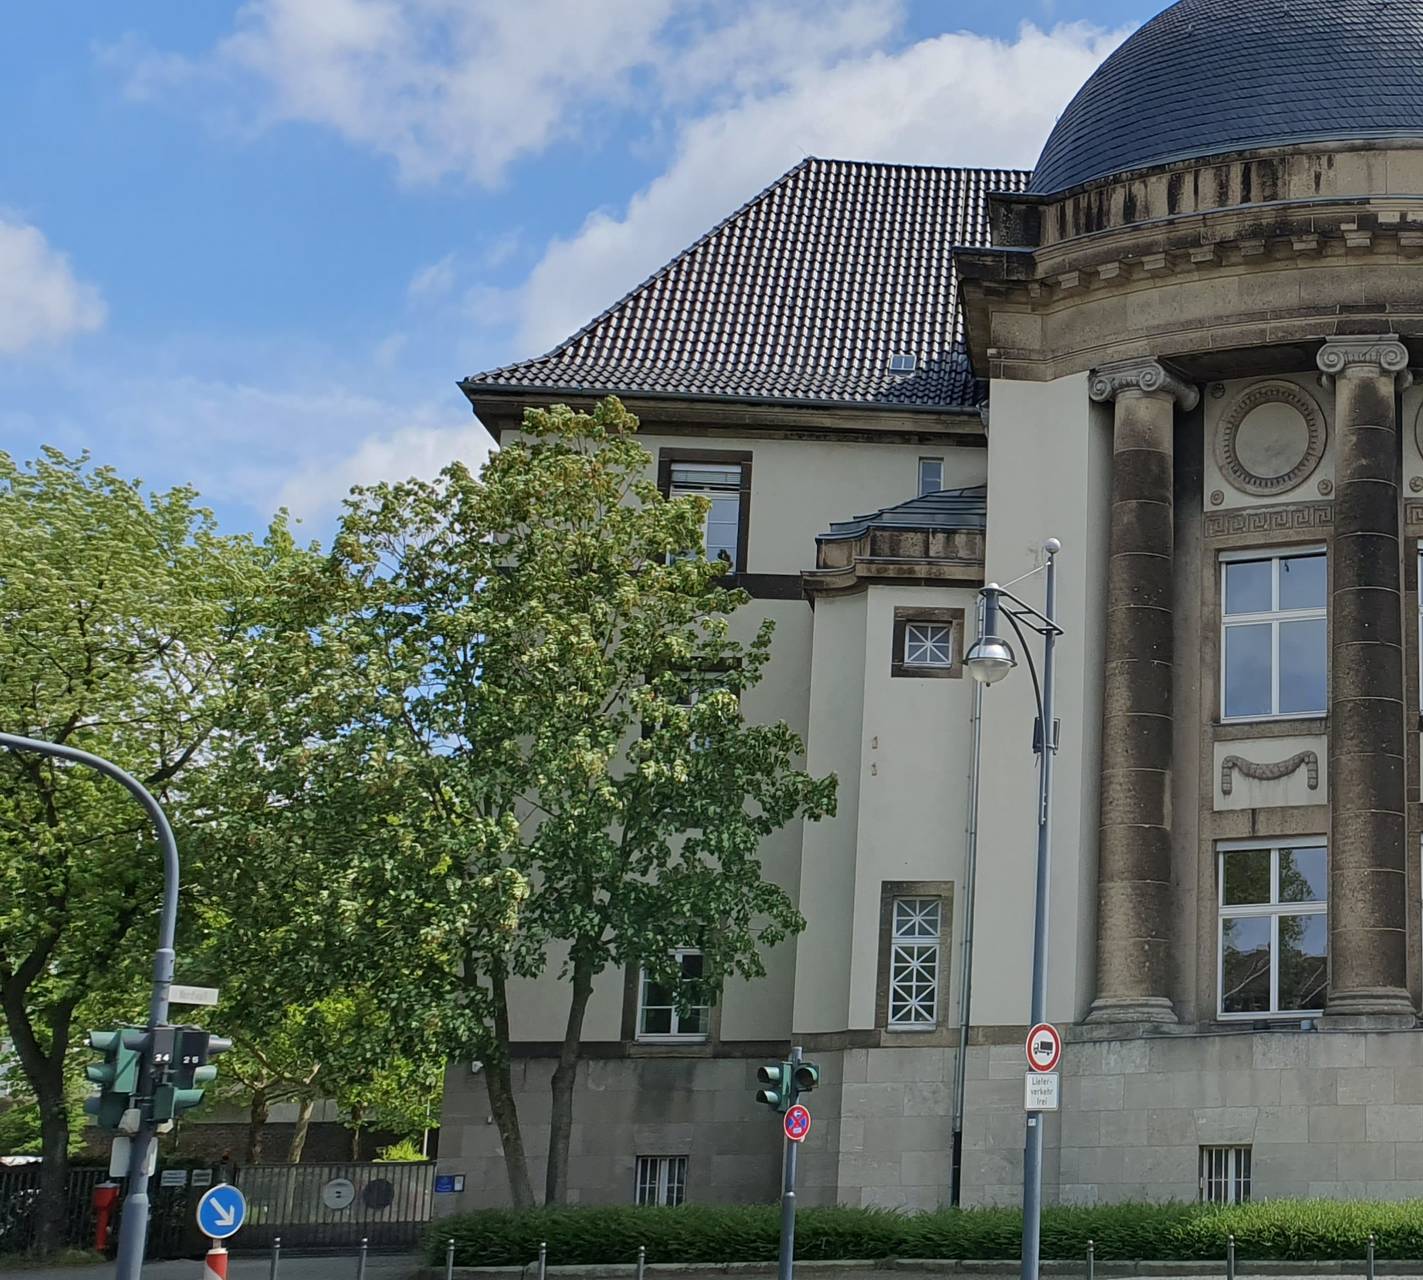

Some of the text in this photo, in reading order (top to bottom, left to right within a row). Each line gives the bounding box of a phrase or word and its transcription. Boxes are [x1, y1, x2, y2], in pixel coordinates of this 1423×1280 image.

[1031, 1076, 1053, 1086] Liefer-
[1030, 1088, 1054, 1096] verkehr
[1036, 1097, 1048, 1105] frei
